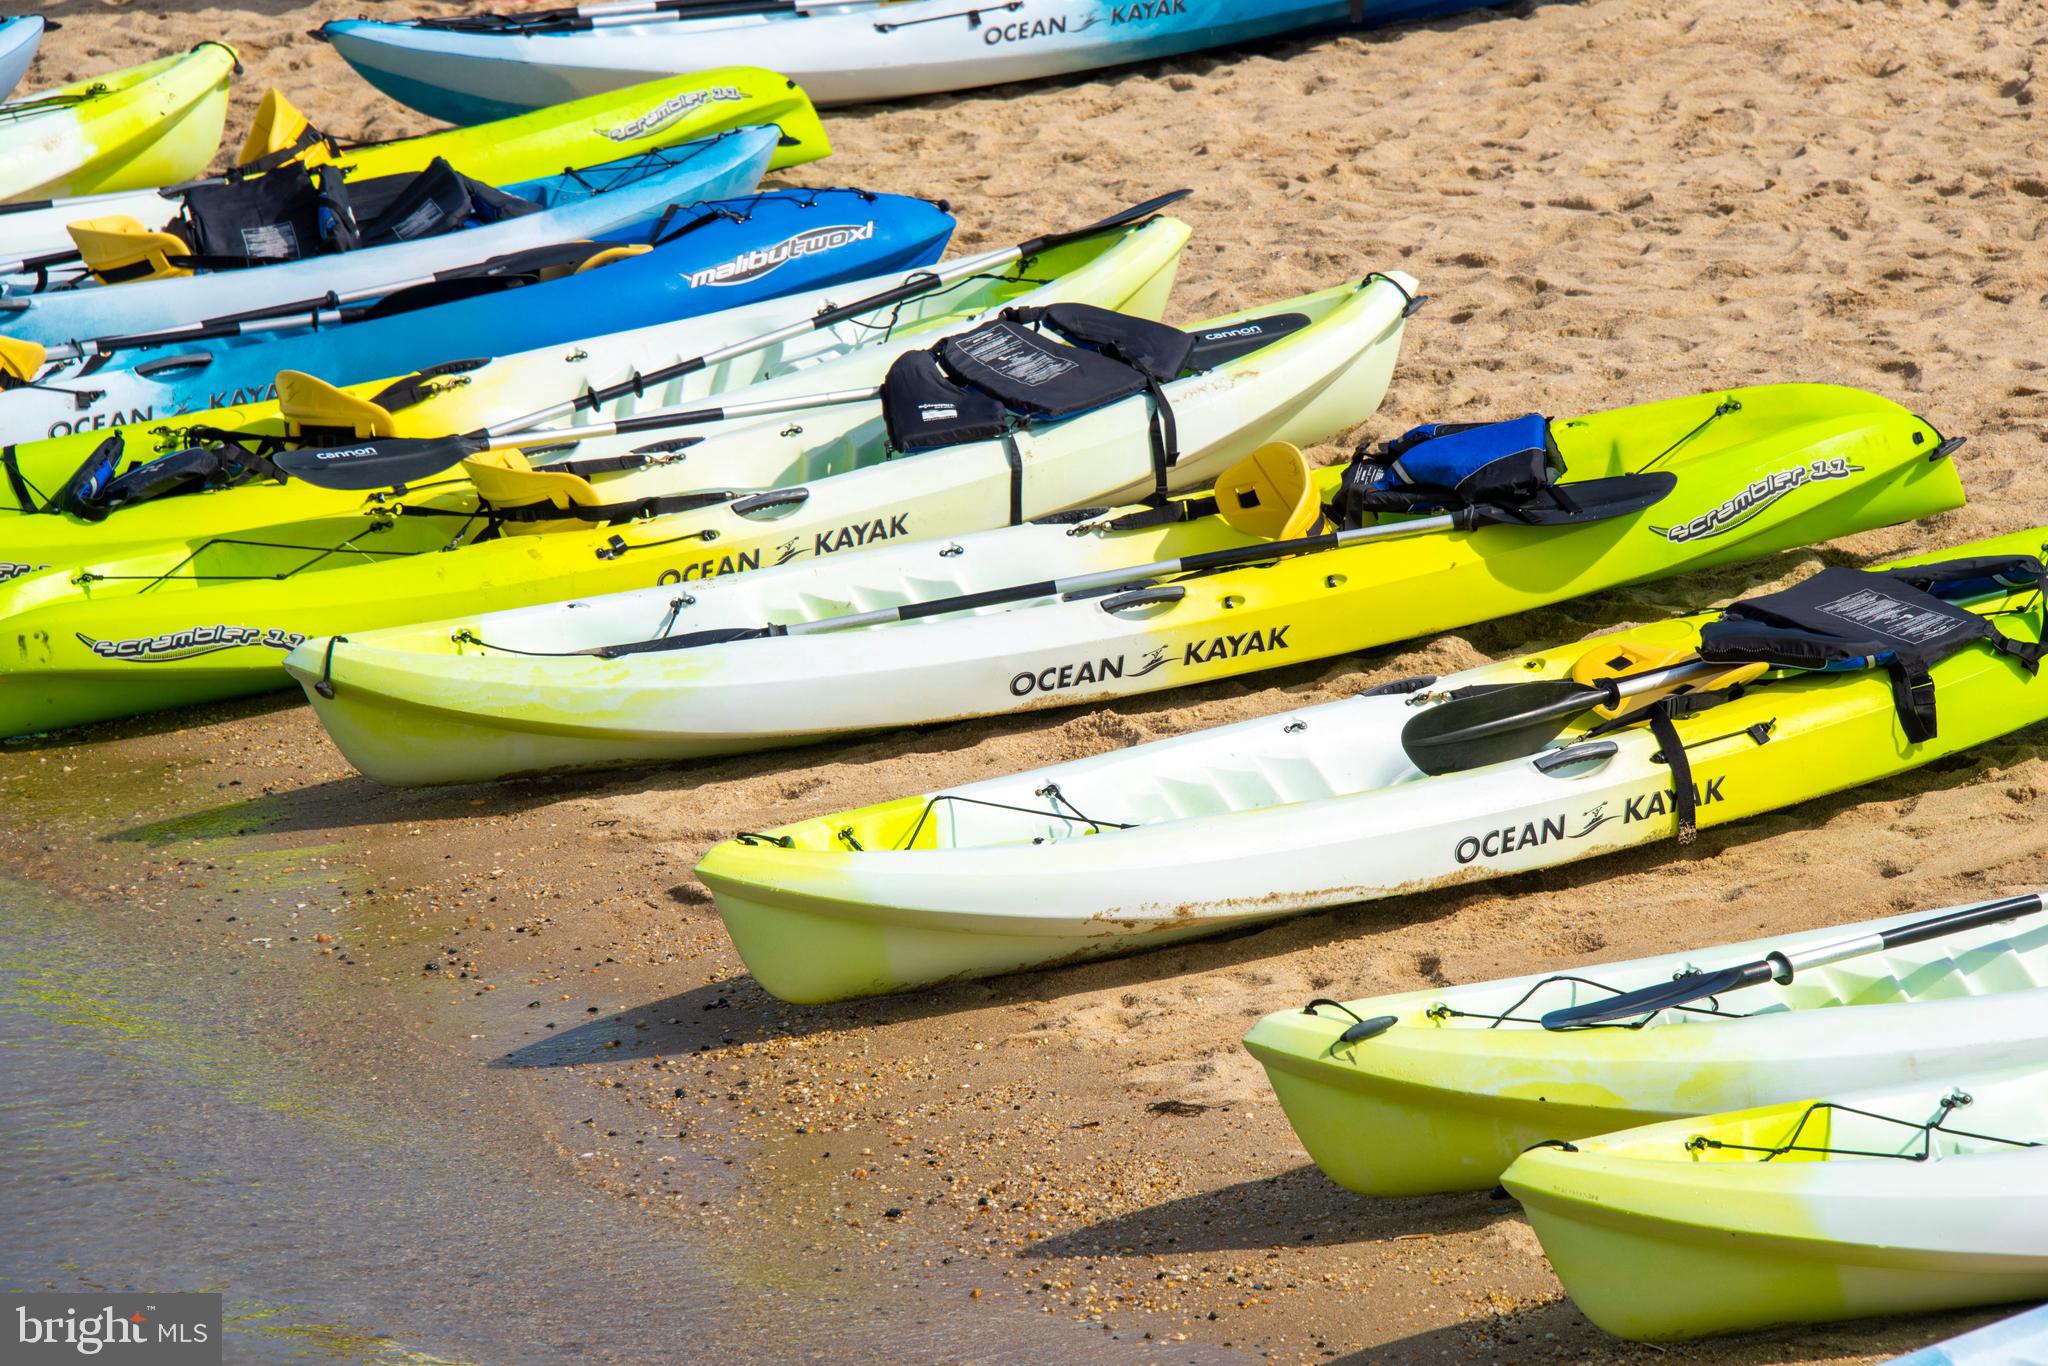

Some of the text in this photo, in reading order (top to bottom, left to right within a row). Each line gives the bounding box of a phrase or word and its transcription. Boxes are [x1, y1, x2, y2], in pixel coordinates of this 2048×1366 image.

[984, 0, 1187, 46] OCEAN KAYAK
[1204, 324, 1262, 340] cannon
[48, 383, 279, 439] OCEAN KAYA
[315, 446, 377, 460] cannon
[1810, 458, 1850, 481] 11
[656, 512, 910, 587] OCEAN KAYAK
[1009, 624, 1291, 697] OCEAN KAYAK
[1454, 813, 1566, 865] OCEAN
